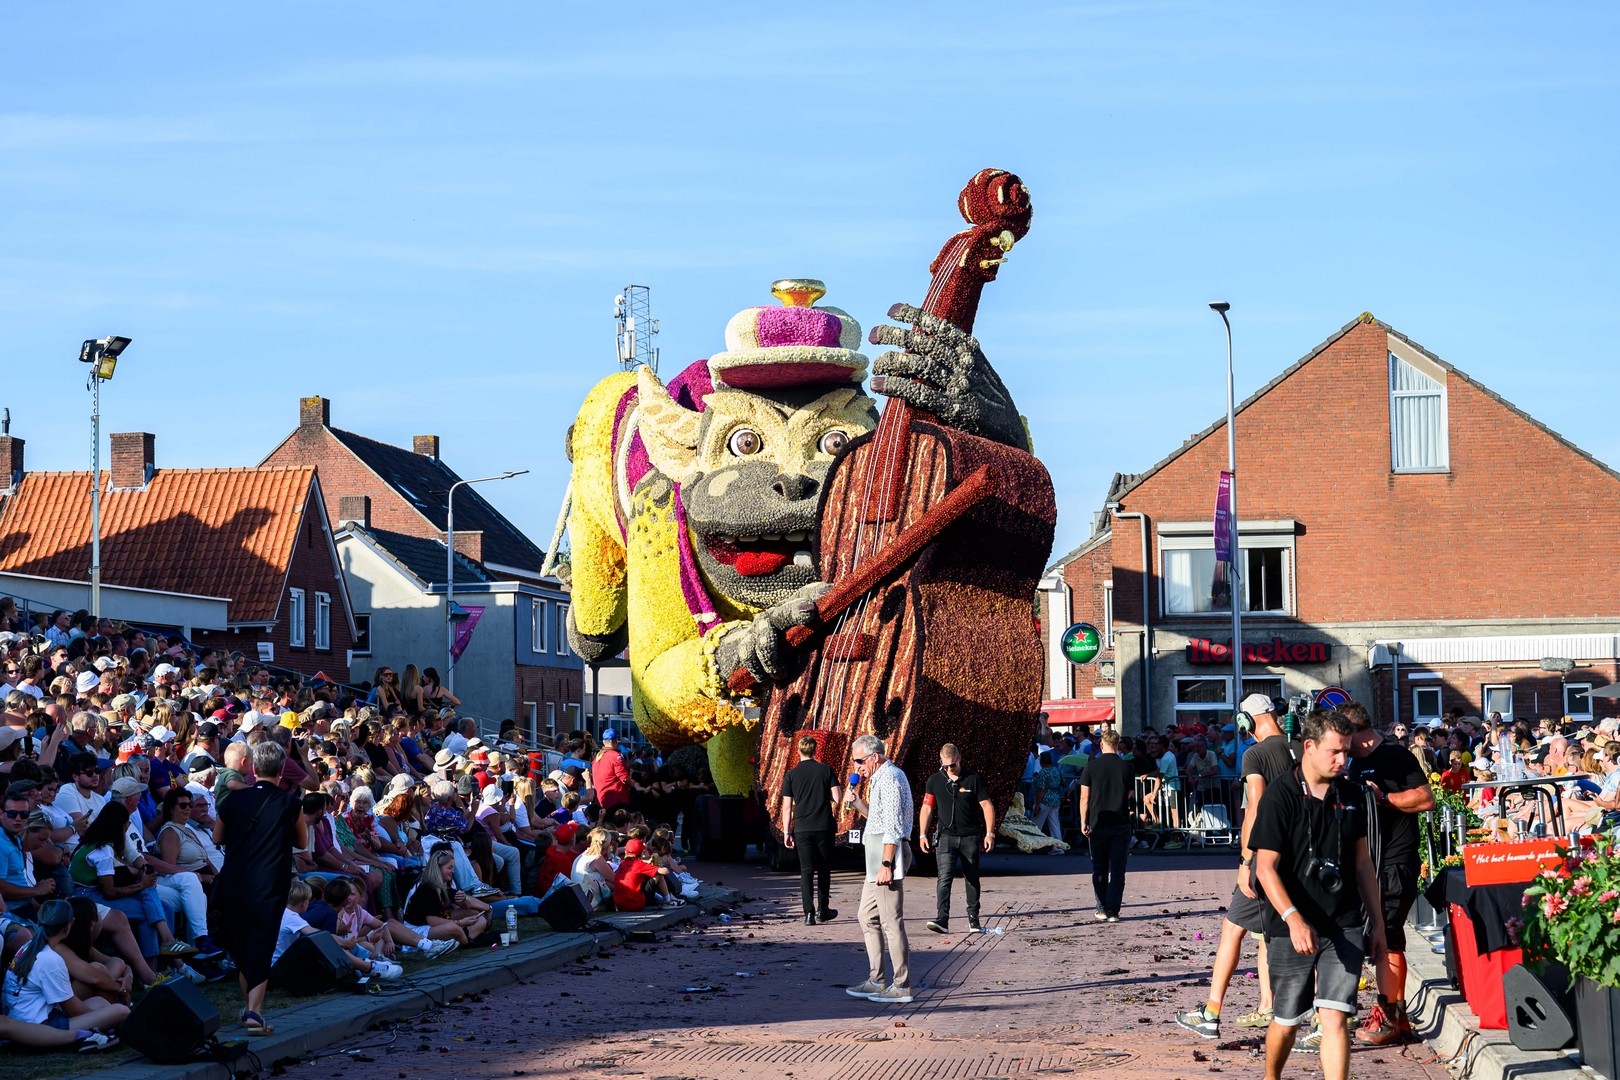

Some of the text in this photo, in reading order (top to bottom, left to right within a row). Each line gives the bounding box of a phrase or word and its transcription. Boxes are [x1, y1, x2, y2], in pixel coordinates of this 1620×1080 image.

[1189, 637, 1328, 663] Heineken
[1491, 854, 1505, 863] best
[1507, 851, 1535, 862] bewaarde
